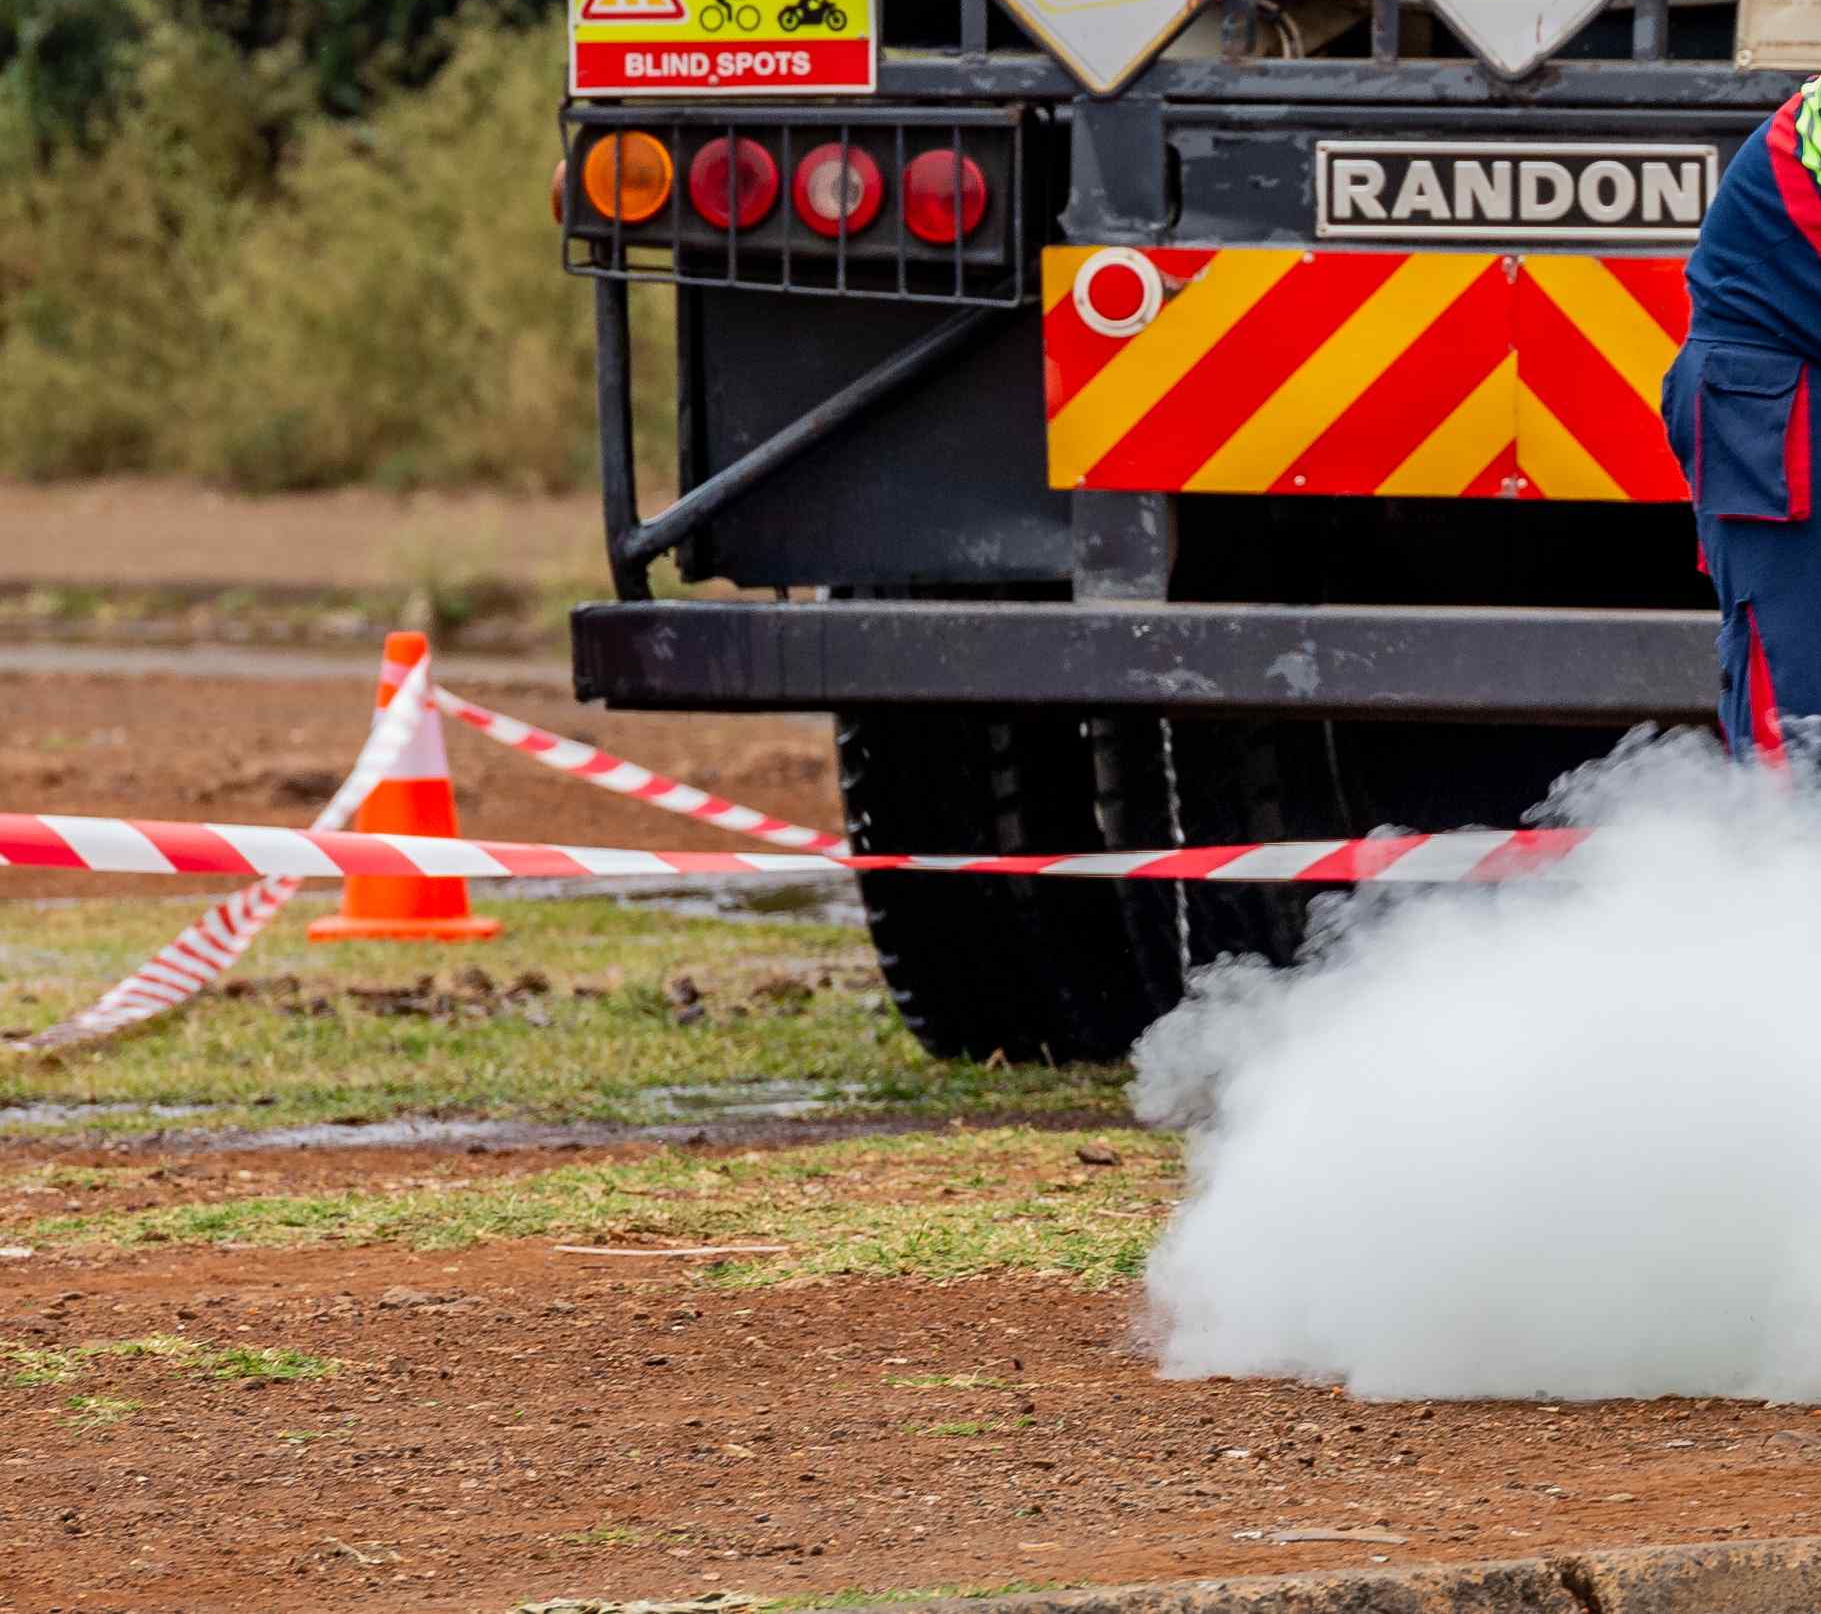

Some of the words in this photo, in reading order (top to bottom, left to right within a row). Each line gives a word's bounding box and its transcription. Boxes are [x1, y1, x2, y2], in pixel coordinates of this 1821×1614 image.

[625, 52, 709, 78] BLIND
[716, 51, 811, 75] SPOTS
[1332, 159, 1701, 223] RANDON
